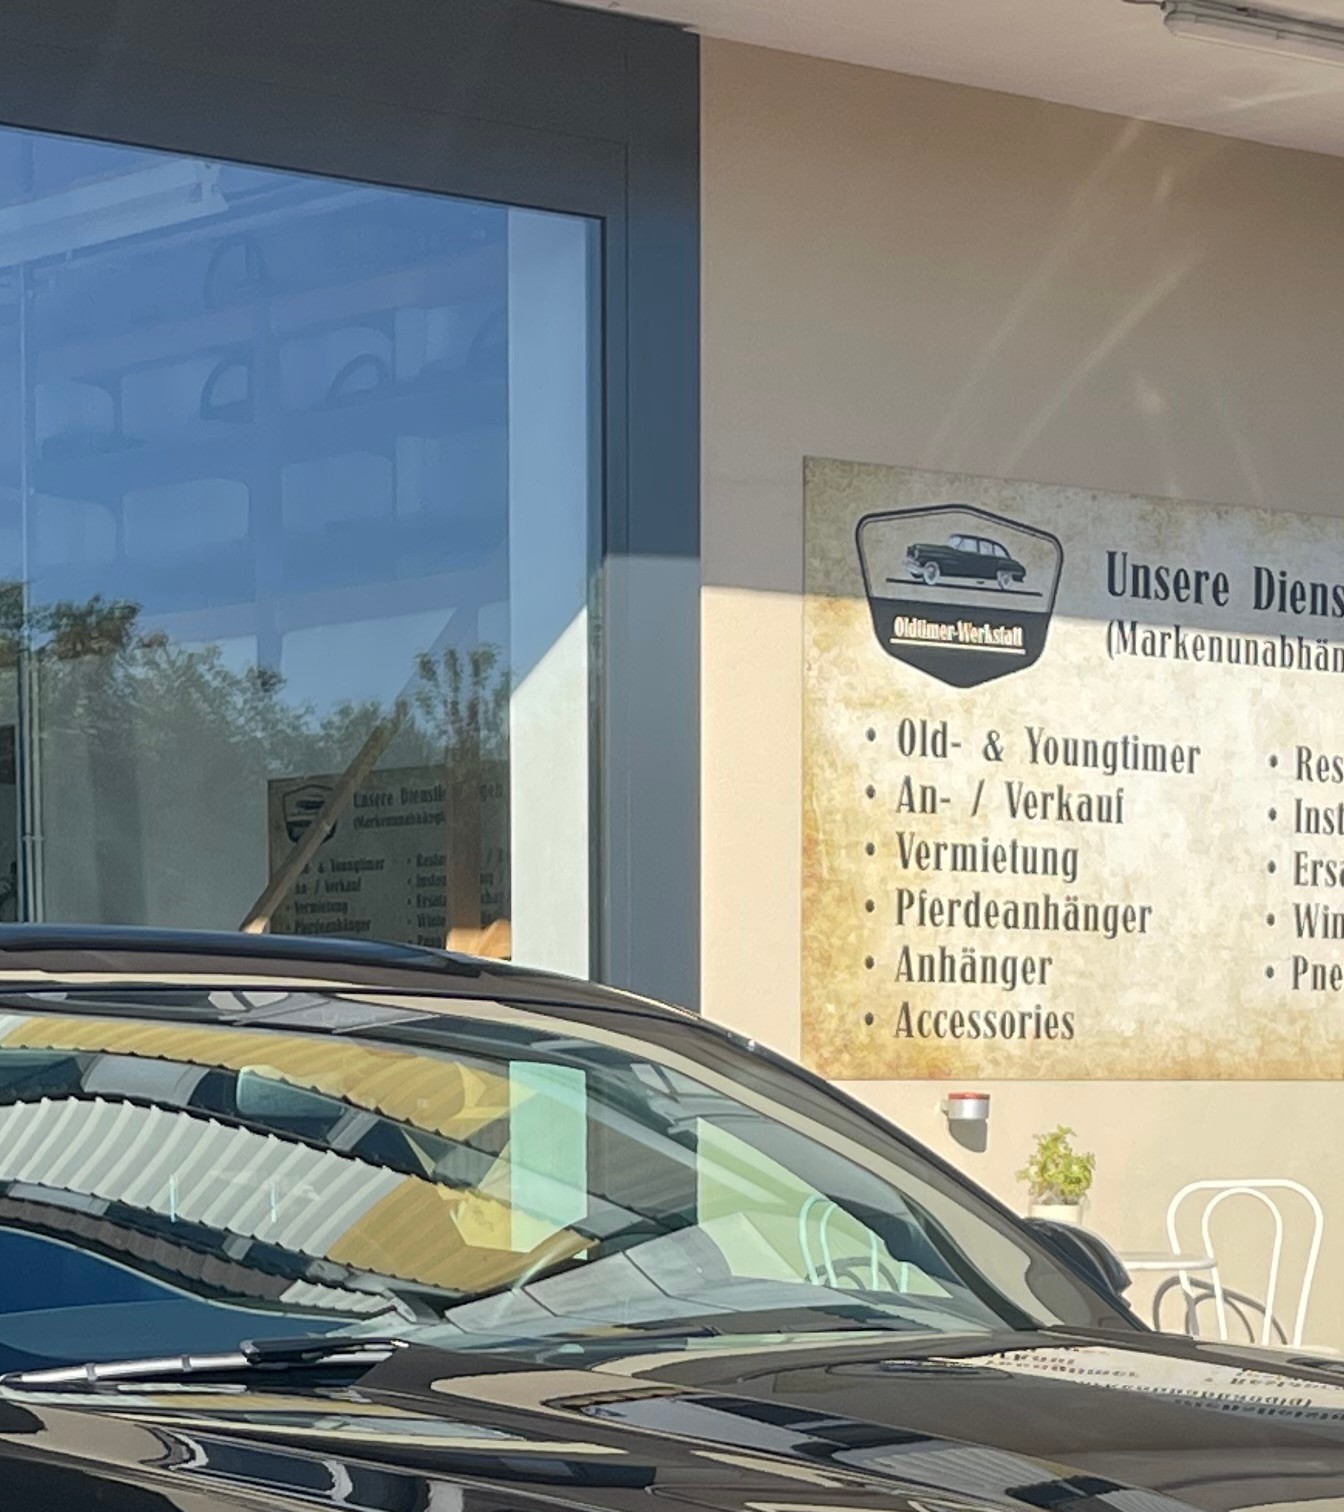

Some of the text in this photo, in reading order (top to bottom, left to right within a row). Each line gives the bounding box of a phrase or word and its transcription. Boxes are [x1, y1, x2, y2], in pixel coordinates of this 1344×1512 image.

[1107, 551, 1229, 607] Unsere
[898, 718, 1200, 776] Old- & Youngtimer
[896, 776, 1123, 824] An- / Verkauf
[896, 832, 1078, 883] Vermietung
[896, 889, 1153, 938] Pferdeanhänger
[895, 945, 1052, 991] Anhänger
[894, 1002, 1074, 1040] Accessories
